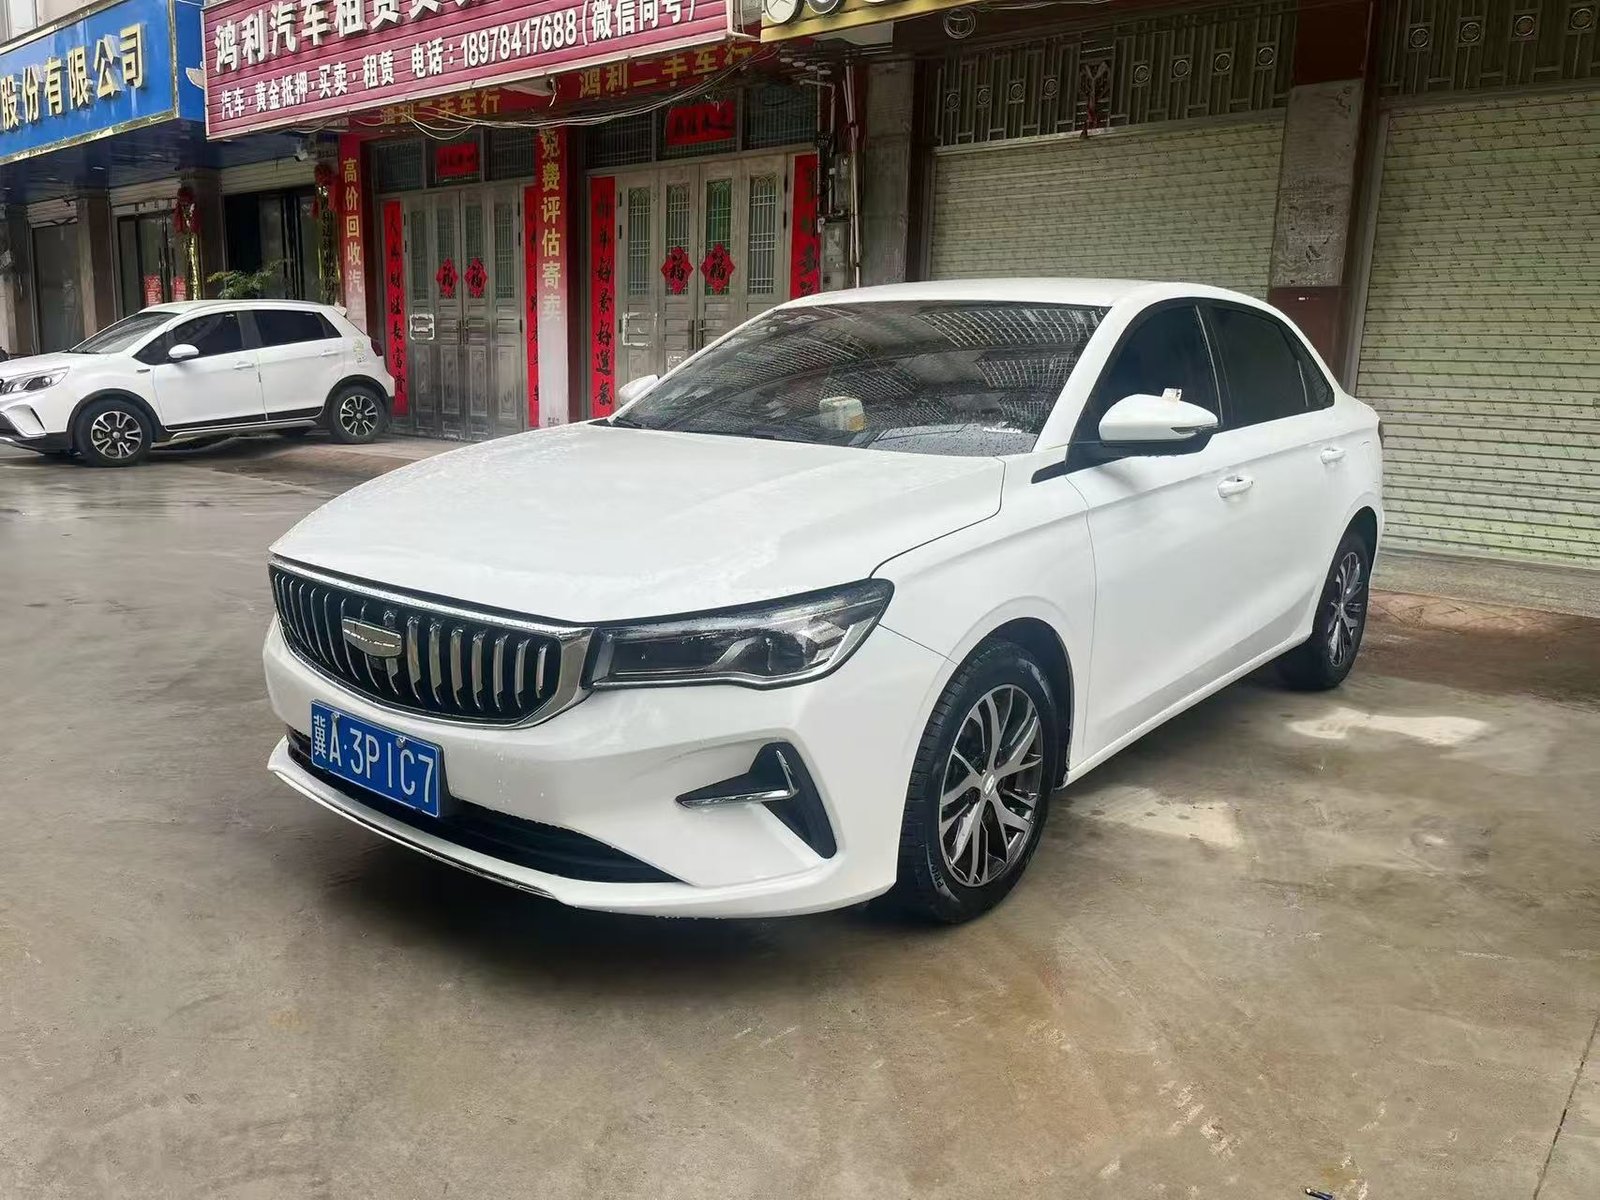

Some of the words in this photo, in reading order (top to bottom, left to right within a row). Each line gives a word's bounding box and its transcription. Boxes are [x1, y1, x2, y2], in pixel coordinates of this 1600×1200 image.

[1, 23, 143, 130] 股份有限公司
